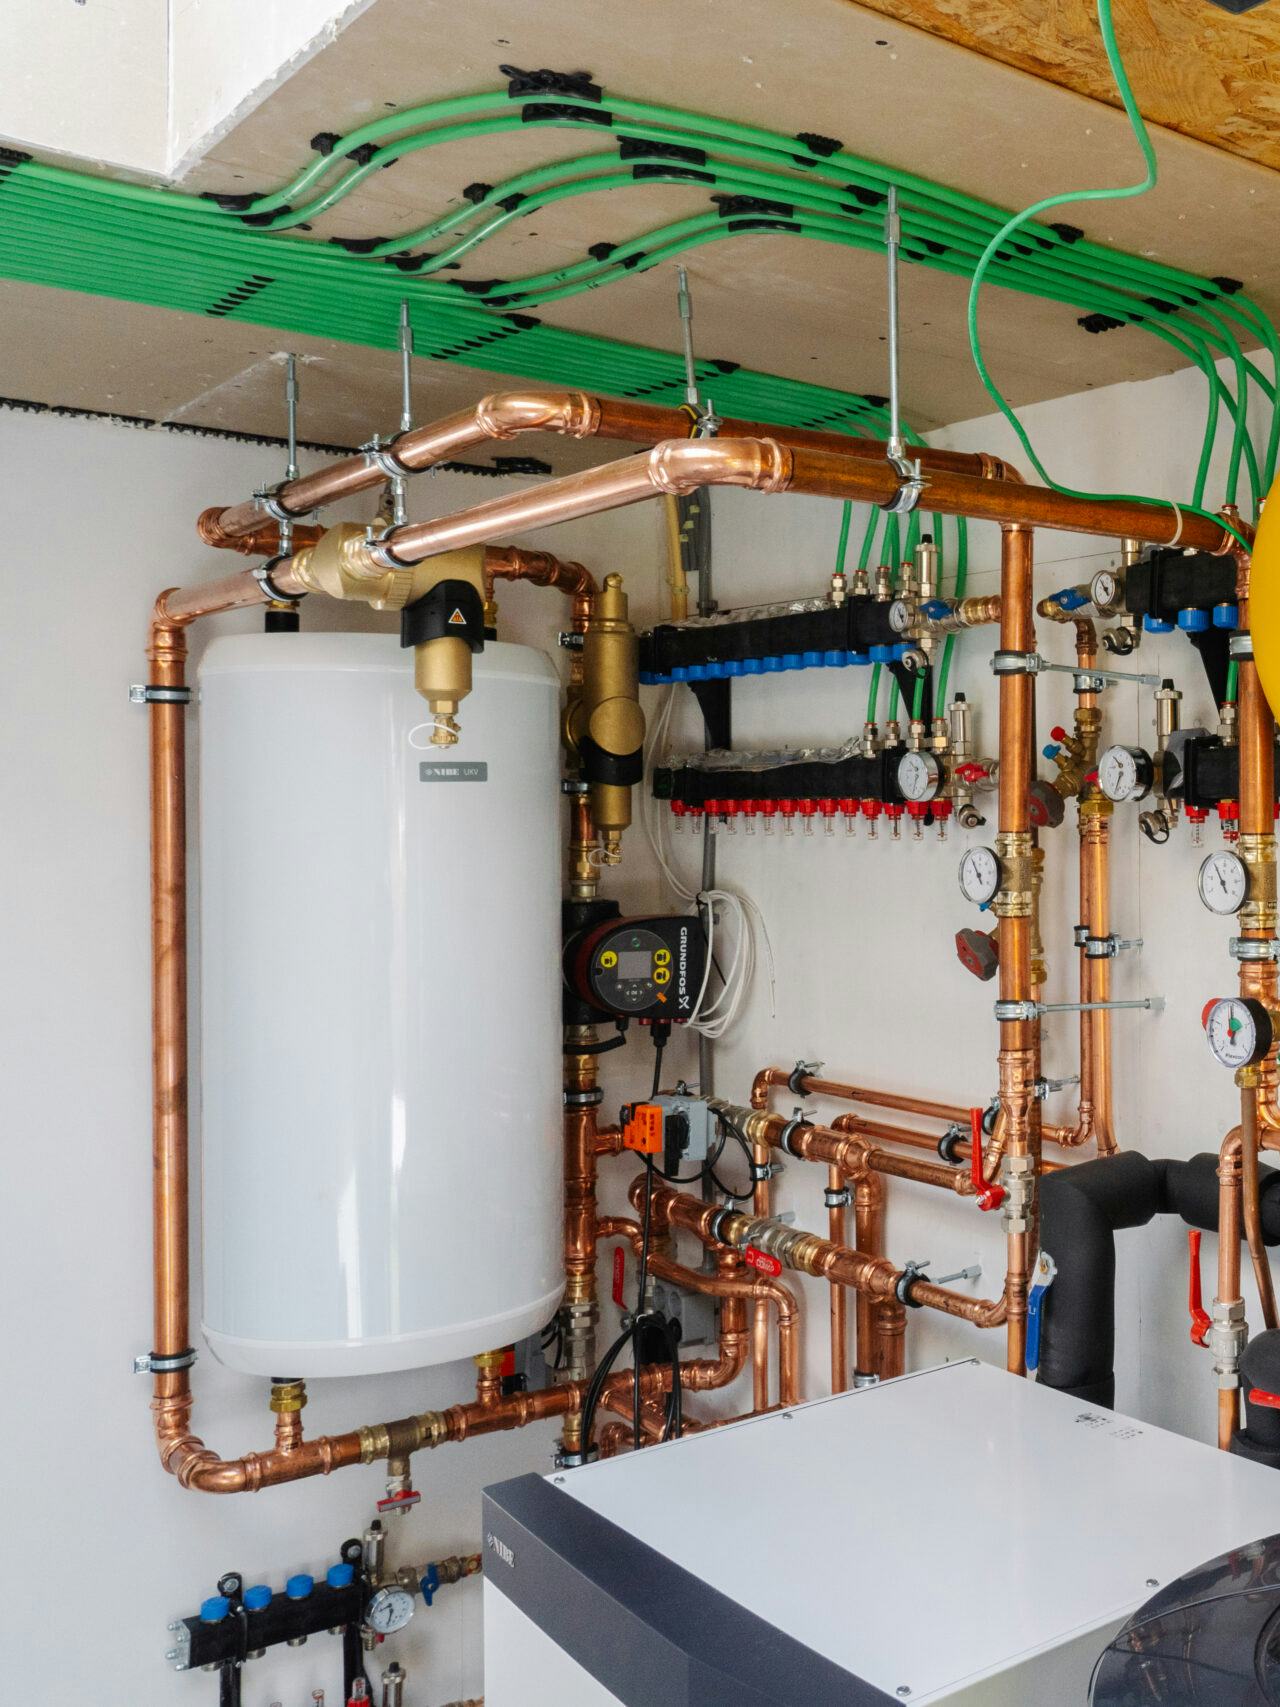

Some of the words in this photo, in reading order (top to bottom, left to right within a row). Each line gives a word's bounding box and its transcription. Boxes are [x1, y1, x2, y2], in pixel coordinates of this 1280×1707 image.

[433, 768, 460, 776] NIBE
[463, 768, 478, 776] UKV
[678, 926, 688, 995] GRUNDFOS
[492, 1535, 515, 1568] NIBE
